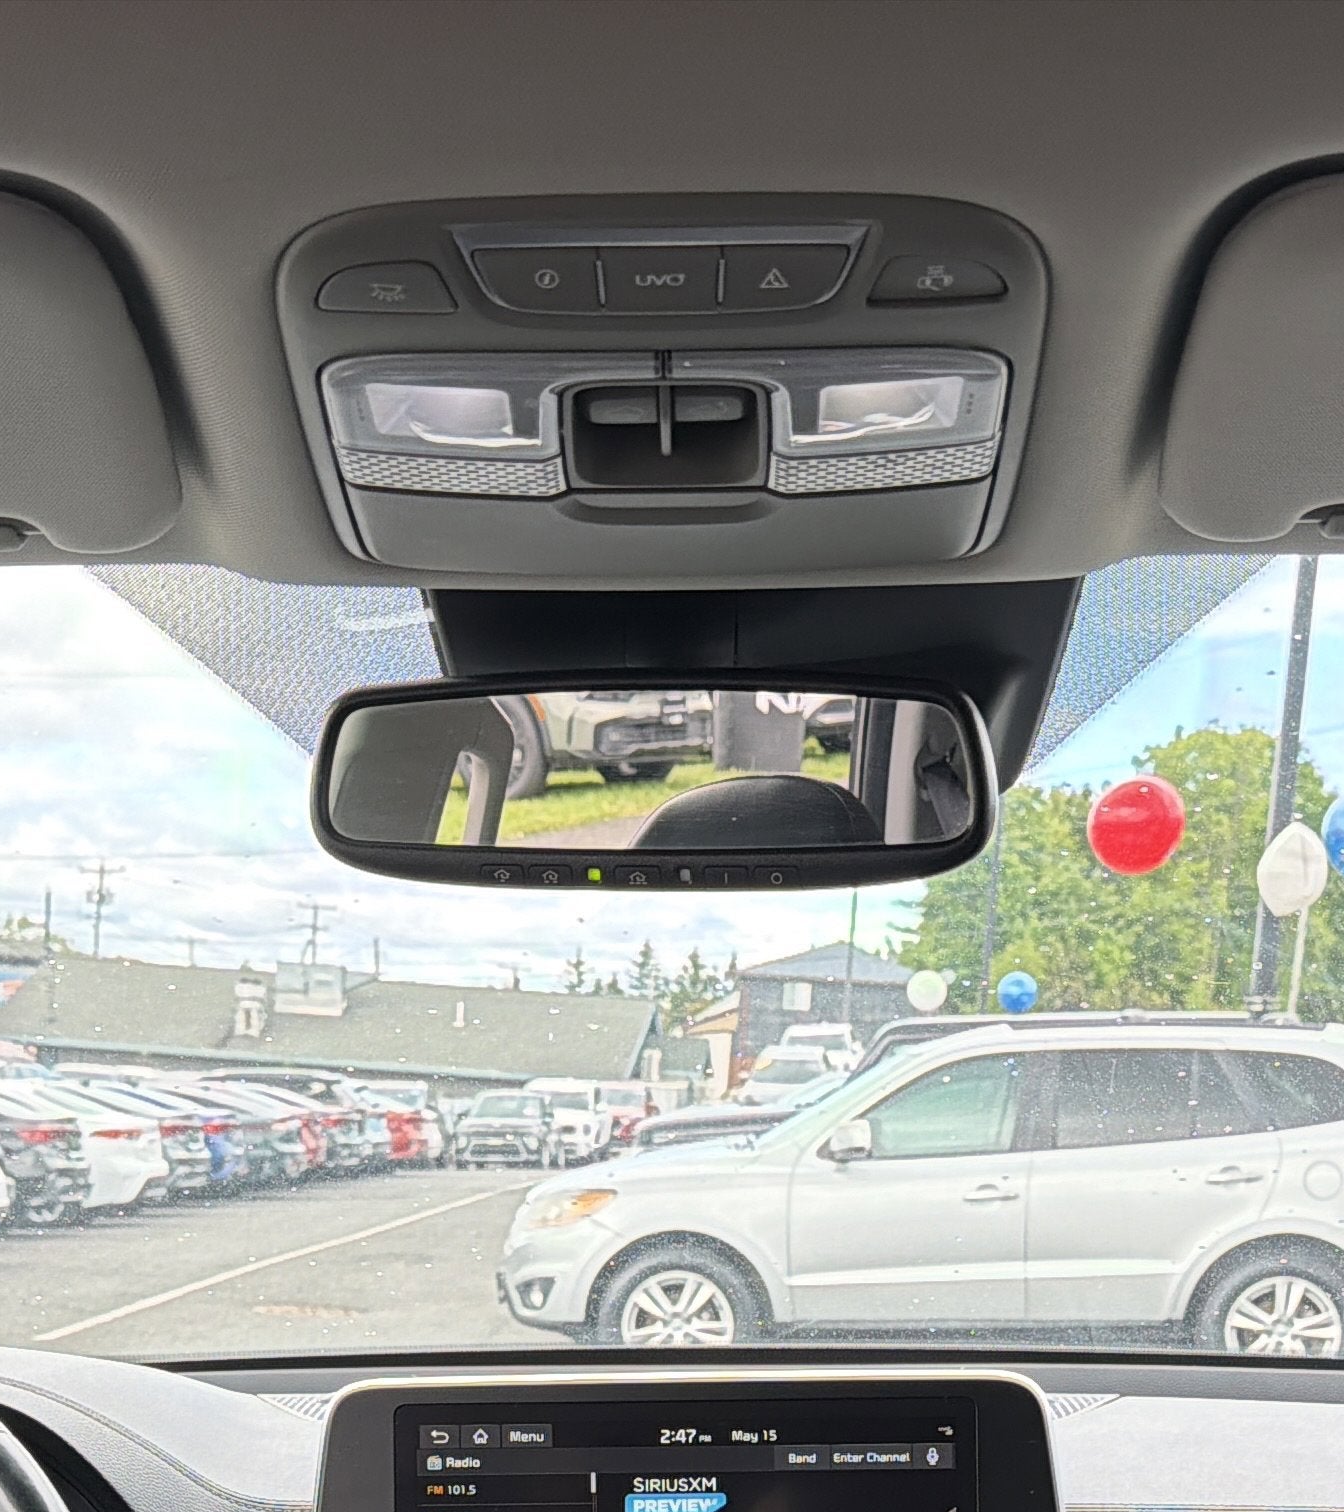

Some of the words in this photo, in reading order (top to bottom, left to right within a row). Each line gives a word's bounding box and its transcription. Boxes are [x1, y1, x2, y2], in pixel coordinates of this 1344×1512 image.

[509, 1431, 545, 1443] Menu
[660, 1428, 697, 1444] 2:47
[731, 1430, 759, 1443] May
[763, 1429, 778, 1442] 15
[446, 1457, 481, 1468] Radio
[788, 1453, 817, 1464] Band
[833, 1453, 864, 1463] Enter
[866, 1452, 910, 1463] Channel
[427, 1485, 444, 1495] FM
[447, 1485, 477, 1496] 101.5
[633, 1477, 717, 1493] SIRIUSXM
